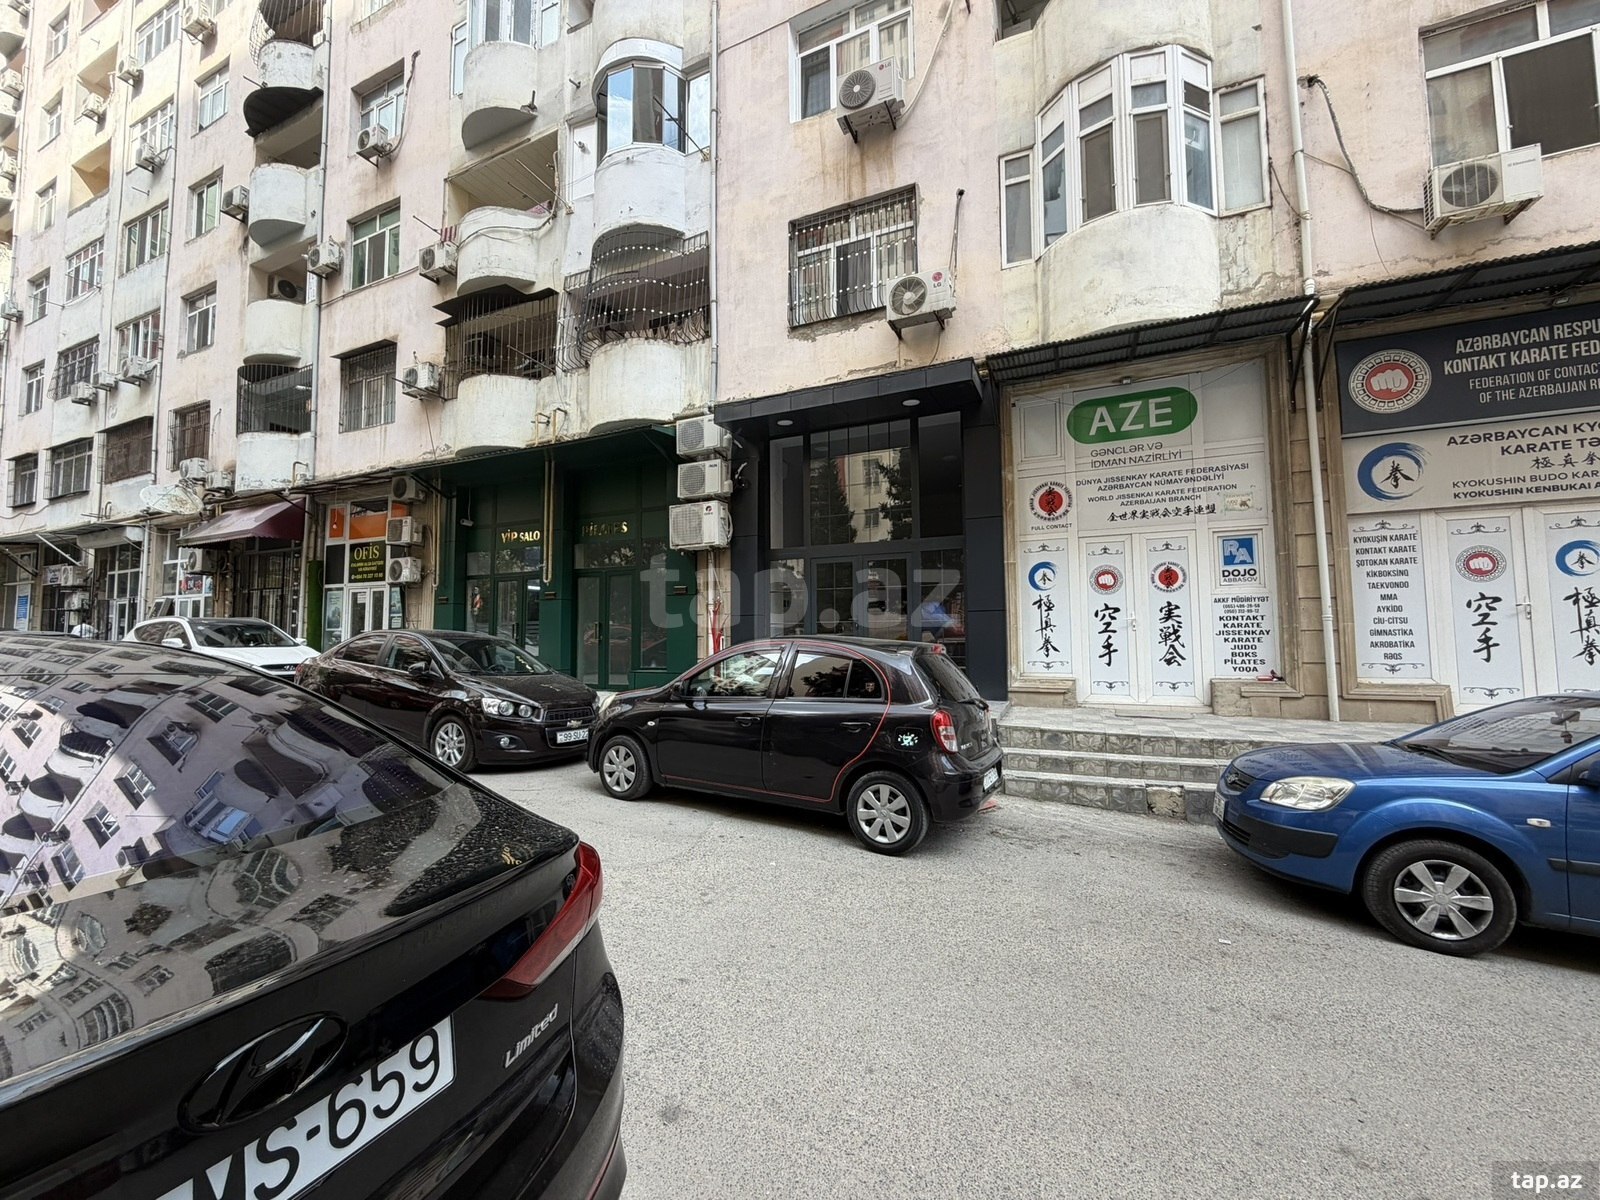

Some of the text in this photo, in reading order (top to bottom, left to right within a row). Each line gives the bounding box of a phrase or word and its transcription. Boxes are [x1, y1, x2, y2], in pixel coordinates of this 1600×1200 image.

[1455, 326, 1550, 354] AZƏRBAYCAN
[1443, 339, 1600, 375] KONTAKT KARATE FED
[1469, 371, 1535, 390] FEDERATION
[1537, 369, 1551, 380] OF
[1479, 391, 1492, 404] OF
[1495, 389, 1516, 401] THE
[1519, 379, 1587, 399] AZERBAIJAN
[1089, 396, 1173, 436] AZE
[1447, 424, 1568, 446] AZƏRBAYCAN
[1090, 441, 1163, 457] GƏNCLƏR VƏ
[1501, 437, 1600, 456] KARATE TƏ
[1091, 449, 1182, 469] İDMAN NAZİRLİYİ
[1076, 462, 1249, 487] DÜNYA JISSENKAY KARATE FEDERASİYASI
[1097, 473, 1225, 492] AZƏRBAYCAN NÜMAYƏNDƏLİYİ
[1452, 470, 1600, 489] KYOKUSHIN BUDO KAR
[1088, 483, 1238, 503] WORLD JISSENKAI KARATE FEDERATION
[1120, 493, 1201, 507] AZERBAIJAN BRANCH
[1453, 487, 1524, 500] KYOKUSHIN
[1526, 482, 1591, 494] KENBUKAI
[1353, 532, 1418, 544] KYOKUŞİN KARATE
[354, 542, 380, 561] OFİS
[1355, 545, 1417, 556] KONTAKT KARATE
[1356, 556, 1418, 568] ŞOTOKAN KARATE
[1222, 568, 1257, 578] DOJO
[1367, 581, 1410, 590] TAEKVONDO
[1380, 593, 1398, 601] MMA
[1376, 603, 1404, 613] AYKİDO
[1219, 614, 1266, 622] KONTAKT
[1372, 616, 1409, 625] CİU-CİTSU
[1466, 591, 1503, 663] 空手
[1094, 602, 1121, 667] 空手
[1158, 601, 1187, 667] 実戦会
[1369, 628, 1414, 637] GİMNASTİKA
[1369, 640, 1416, 649] AKROBATİKA
[1223, 657, 1266, 665] PİLATES
[1383, 652, 1403, 661] RƏQS
[505, 1003, 559, 1069] Limited
